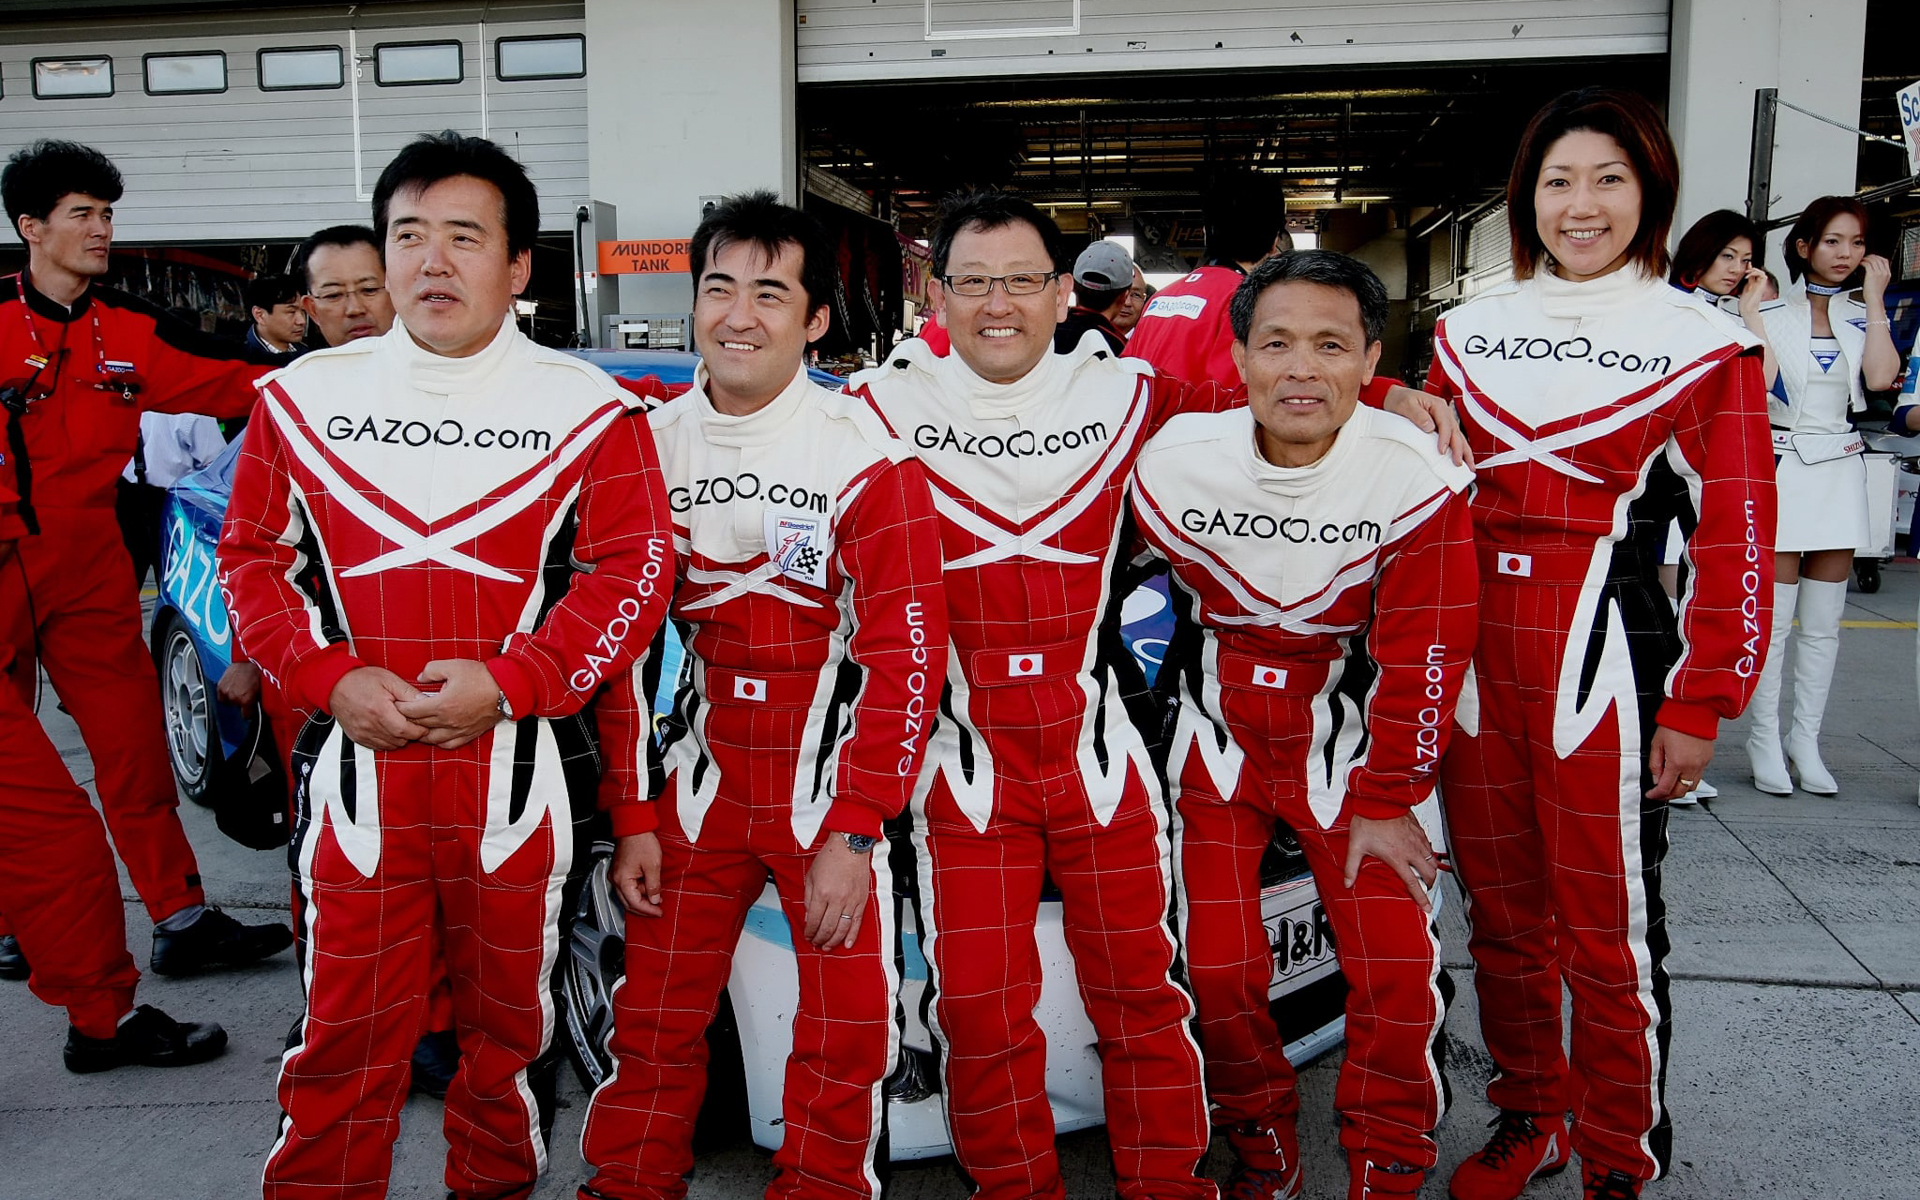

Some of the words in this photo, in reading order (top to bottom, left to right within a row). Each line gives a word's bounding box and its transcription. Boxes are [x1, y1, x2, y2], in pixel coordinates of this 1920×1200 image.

[1901, 86, 1920, 126] Sc
[631, 259, 670, 272] TANK
[1464, 335, 1671, 375] GAZOO.com
[327, 415, 551, 451] GAZOO.com
[914, 422, 1107, 458] GAZOO.com
[668, 473, 828, 514] GZOO.com
[1182, 507, 1381, 544] GAZOO.com
[1735, 500, 1760, 678] GAZOO.com
[569, 538, 666, 691] GAZOO.com
[898, 602, 928, 777] GAZOO.com
